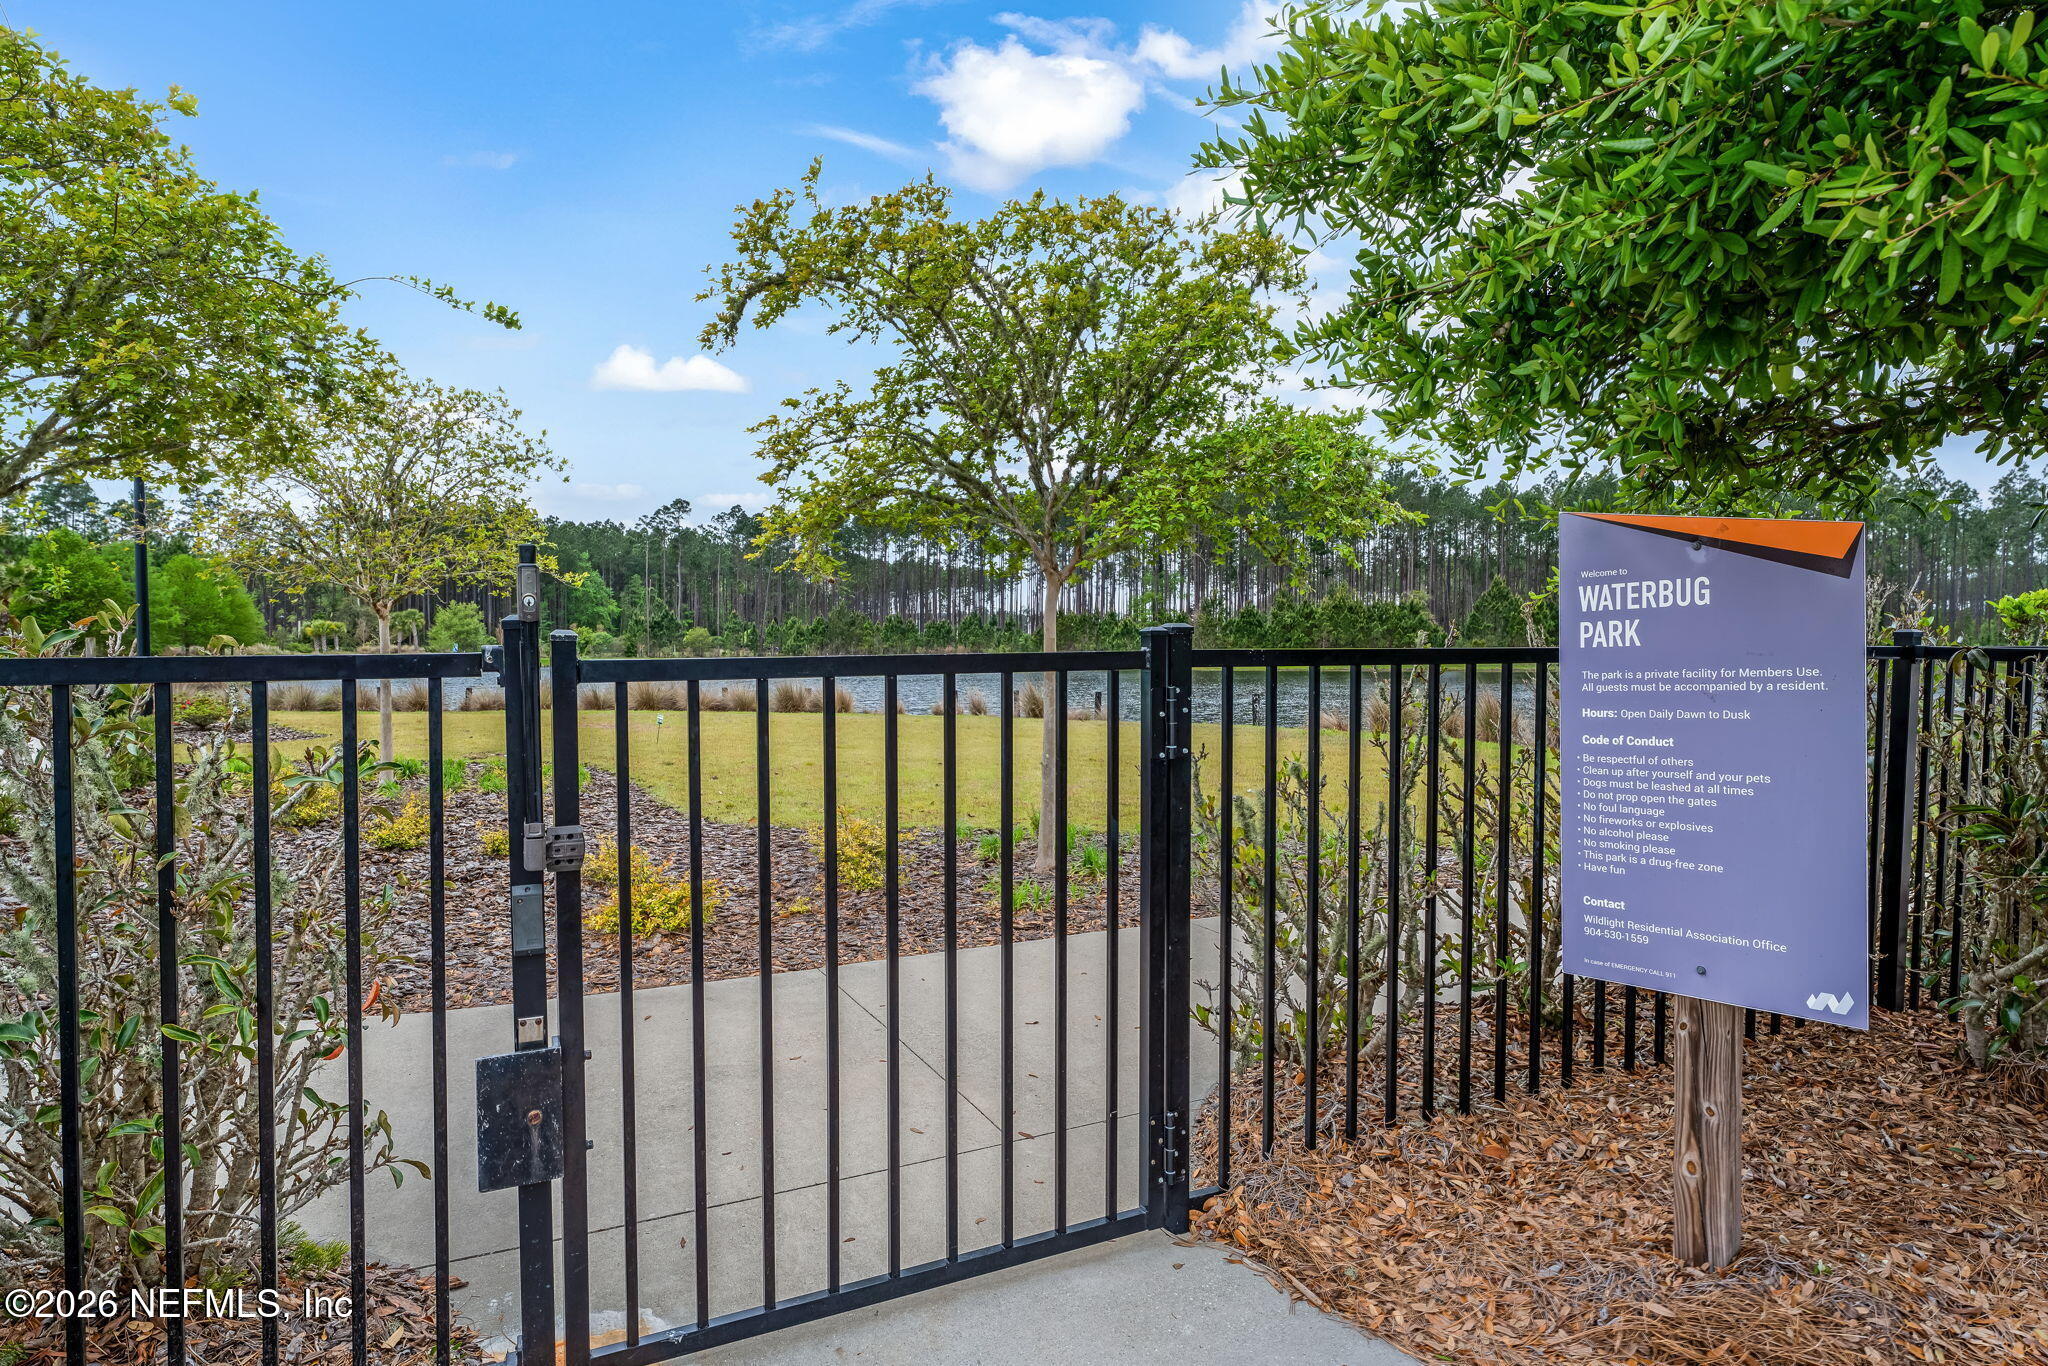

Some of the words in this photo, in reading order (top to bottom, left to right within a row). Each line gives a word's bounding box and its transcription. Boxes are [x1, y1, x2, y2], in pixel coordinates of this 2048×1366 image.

[1579, 577, 1710, 611] WATERBUG
[1580, 619, 1640, 648] PARK
[1582, 671, 1599, 679] The
[1602, 671, 1622, 682] park
[1625, 670, 1633, 678] is
[1645, 670, 1679, 681] private
[1682, 669, 1717, 681] facility
[1721, 668, 1736, 677] for
[1739, 667, 1792, 677] Members
[1797, 667, 1822, 676] Use.
[1582, 683, 1593, 691] All
[1596, 684, 1628, 694] guests
[1631, 683, 1656, 691] must
[1659, 682, 1671, 691] be
[1674, 681, 1746, 694] accompanied
[1750, 681, 1763, 693] by
[1777, 681, 1828, 690] resident.
[1583, 708, 1617, 717] Hours:
[1621, 710, 1646, 721] Open
[1649, 709, 1673, 721] Daily
[1677, 710, 1705, 718] Dawn
[1723, 710, 1750, 719] Dusk
[1582, 735, 1609, 744] Code
[1612, 736, 1624, 745] of
[1627, 736, 1674, 746] Conduct
[1583, 754, 1594, 762] Be
[1598, 755, 1645, 766] respectful
[1648, 756, 1658, 764] of
[1661, 757, 1693, 766] others
[1583, 766, 1608, 775] Clean
[1612, 769, 1623, 778] up
[1626, 768, 1649, 777] after
[1652, 770, 1693, 782] yourself
[1696, 772, 1715, 780] and
[1719, 774, 1743, 784] your
[1746, 775, 1770, 785] pets
[1583, 778, 1607, 789] Dogs
[1637, 781, 1648, 789] be
[1652, 781, 1690, 792] leashed
[1694, 785, 1704, 793] at
[1708, 785, 1719, 793] all
[1723, 785, 1753, 795] times
[1584, 790, 1595, 798] Do
[1616, 794, 1638, 803] prop
[1641, 796, 1665, 804] open
[1668, 795, 1684, 804] the
[1688, 798, 1716, 807] gates
[1584, 802, 1596, 811] No
[1599, 803, 1616, 812] foul
[1620, 804, 1664, 816] language
[1584, 814, 1596, 823] No
[1599, 815, 1643, 826] fireworks
[1659, 821, 1713, 832] explosives
[1584, 826, 1596, 835] No
[1599, 828, 1633, 838] alcohol
[1637, 831, 1669, 842] please
[1584, 838, 1596, 847] No
[1600, 841, 1639, 853] smoking
[1643, 844, 1675, 855] please
[1584, 850, 1603, 860] This
[1606, 854, 1626, 864] park
[1649, 857, 1695, 870] drug-free
[1698, 864, 1723, 872] zone
[1584, 863, 1607, 872] Have
[1610, 865, 1625, 874] fun
[1584, 896, 1625, 909] Contact
[1584, 915, 1624, 929] Wildlight
[1627, 921, 1682, 937] Residential
[1686, 930, 1749, 946] Association
[1753, 939, 1786, 952] Office
[1584, 926, 1649, 944] 904-530-1559
[1611, 963, 1648, 973] EMERGENCY
